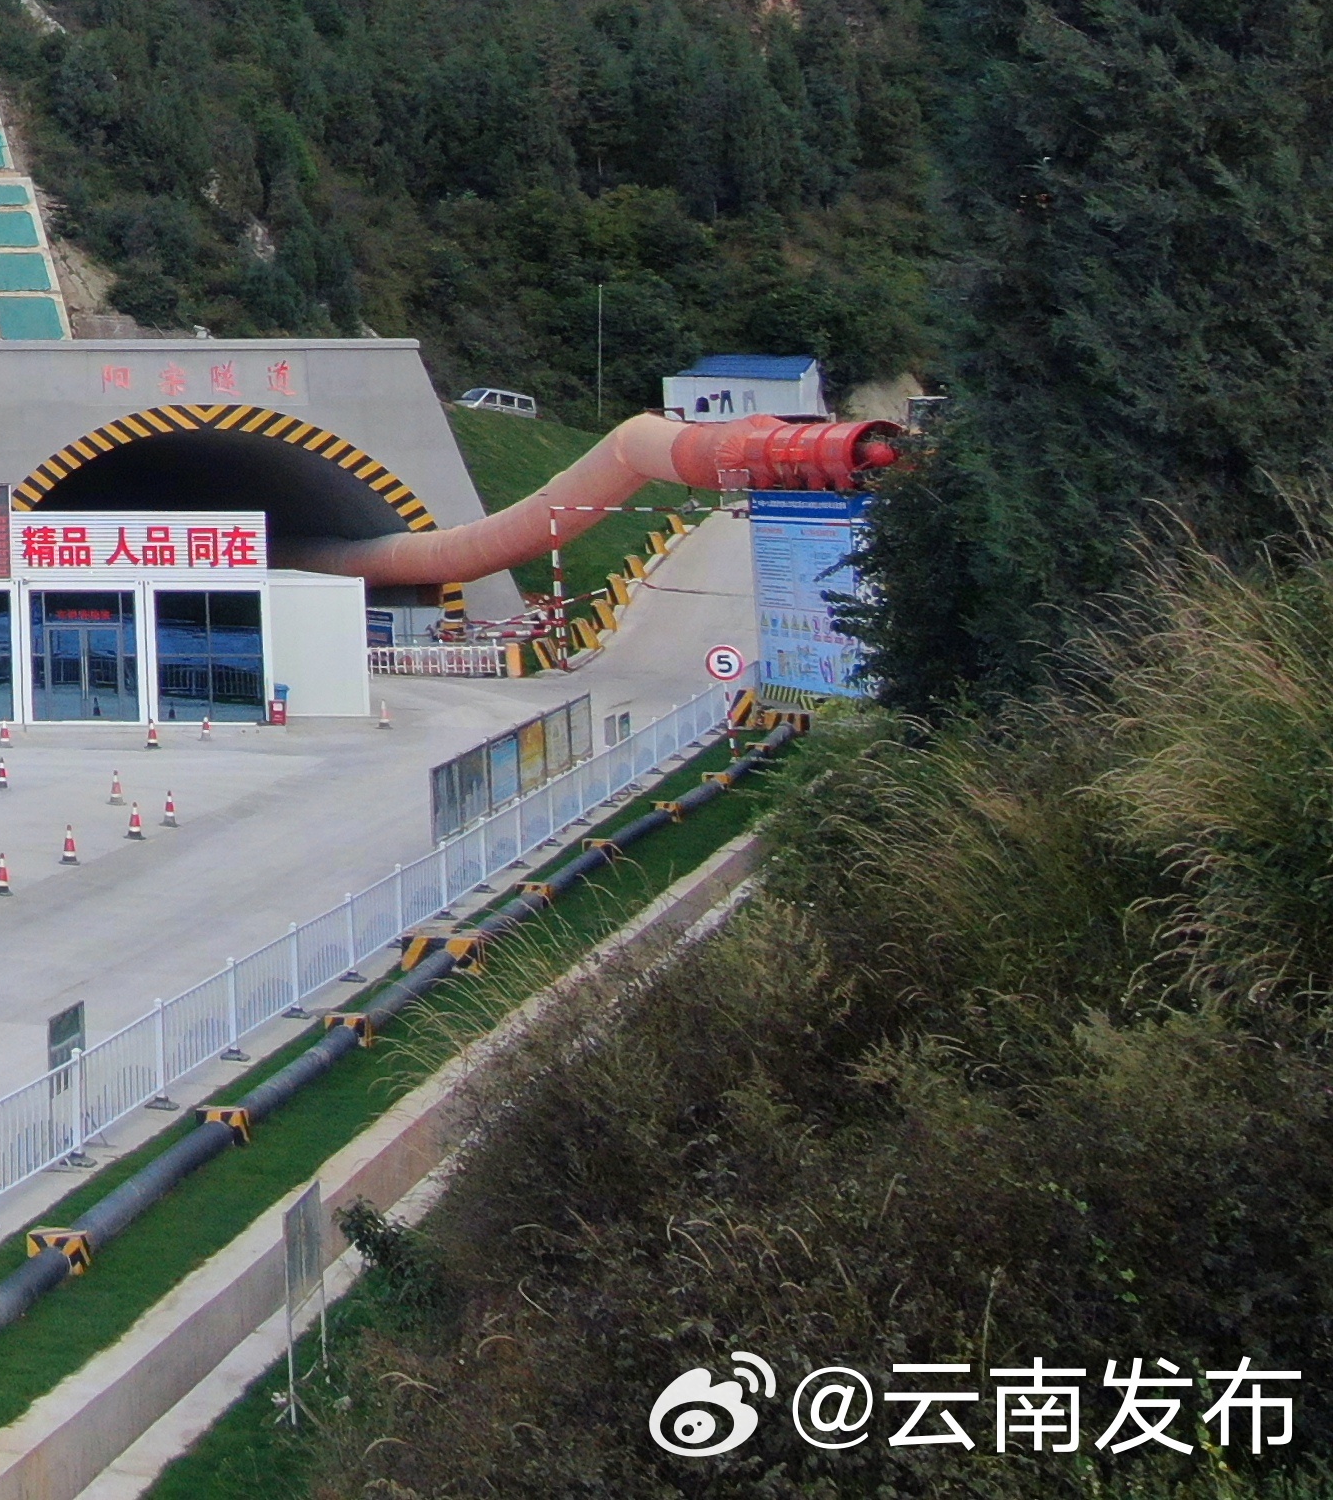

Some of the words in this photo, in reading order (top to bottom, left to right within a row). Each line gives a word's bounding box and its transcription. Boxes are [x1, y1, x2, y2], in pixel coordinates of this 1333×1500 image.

[102, 360, 297, 396] 阳宗隧道
[21, 526, 92, 568] 精品
[105, 526, 176, 567] 人品
[187, 526, 260, 568] 同在
[717, 655, 732, 673] 5
